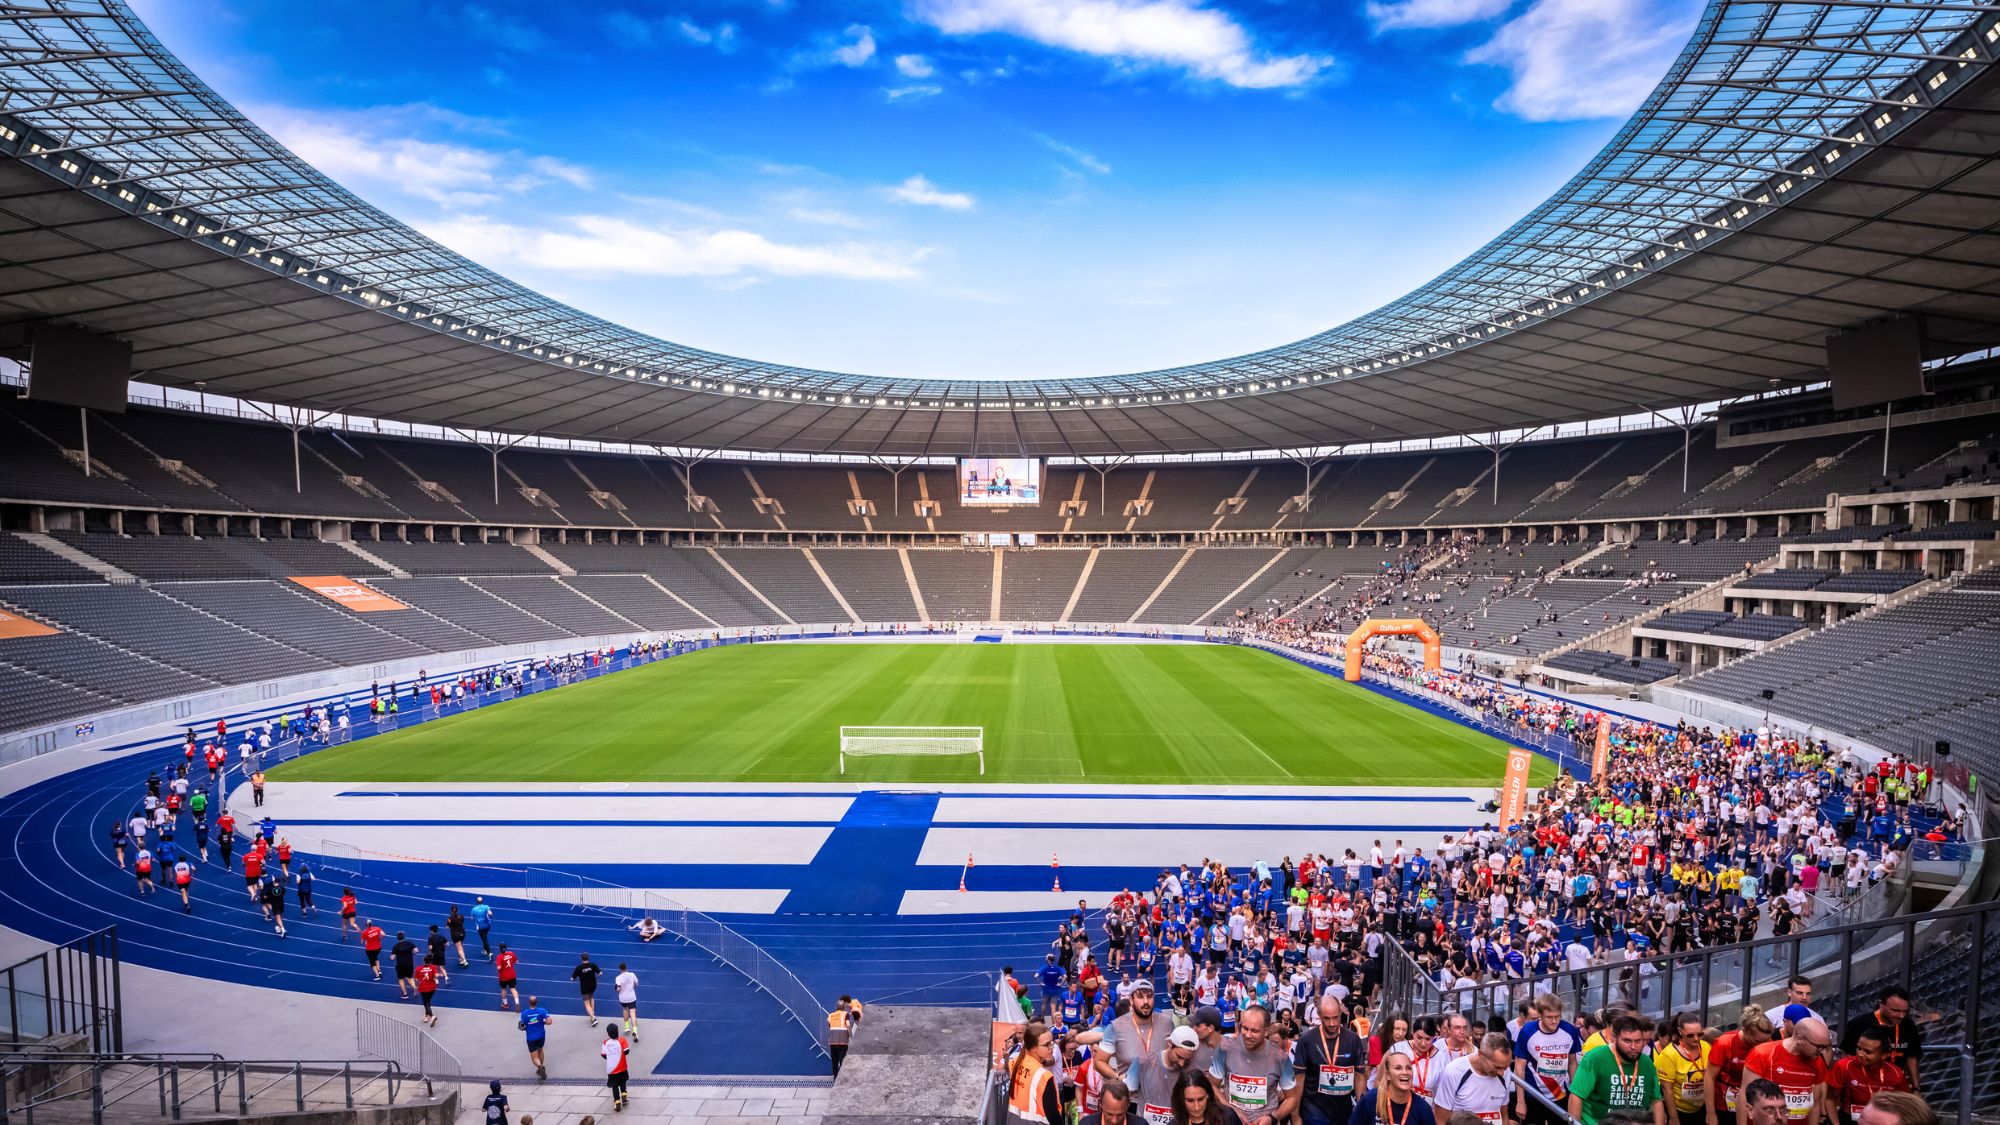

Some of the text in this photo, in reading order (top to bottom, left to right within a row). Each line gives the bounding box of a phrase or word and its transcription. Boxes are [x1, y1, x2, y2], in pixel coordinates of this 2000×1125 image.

[1610, 1074, 1645, 1087] GUTE
[1236, 1084, 1258, 1094] 5727
[1610, 1092, 1644, 1101] FRISCH
[1786, 1095, 1811, 1104] 10574
